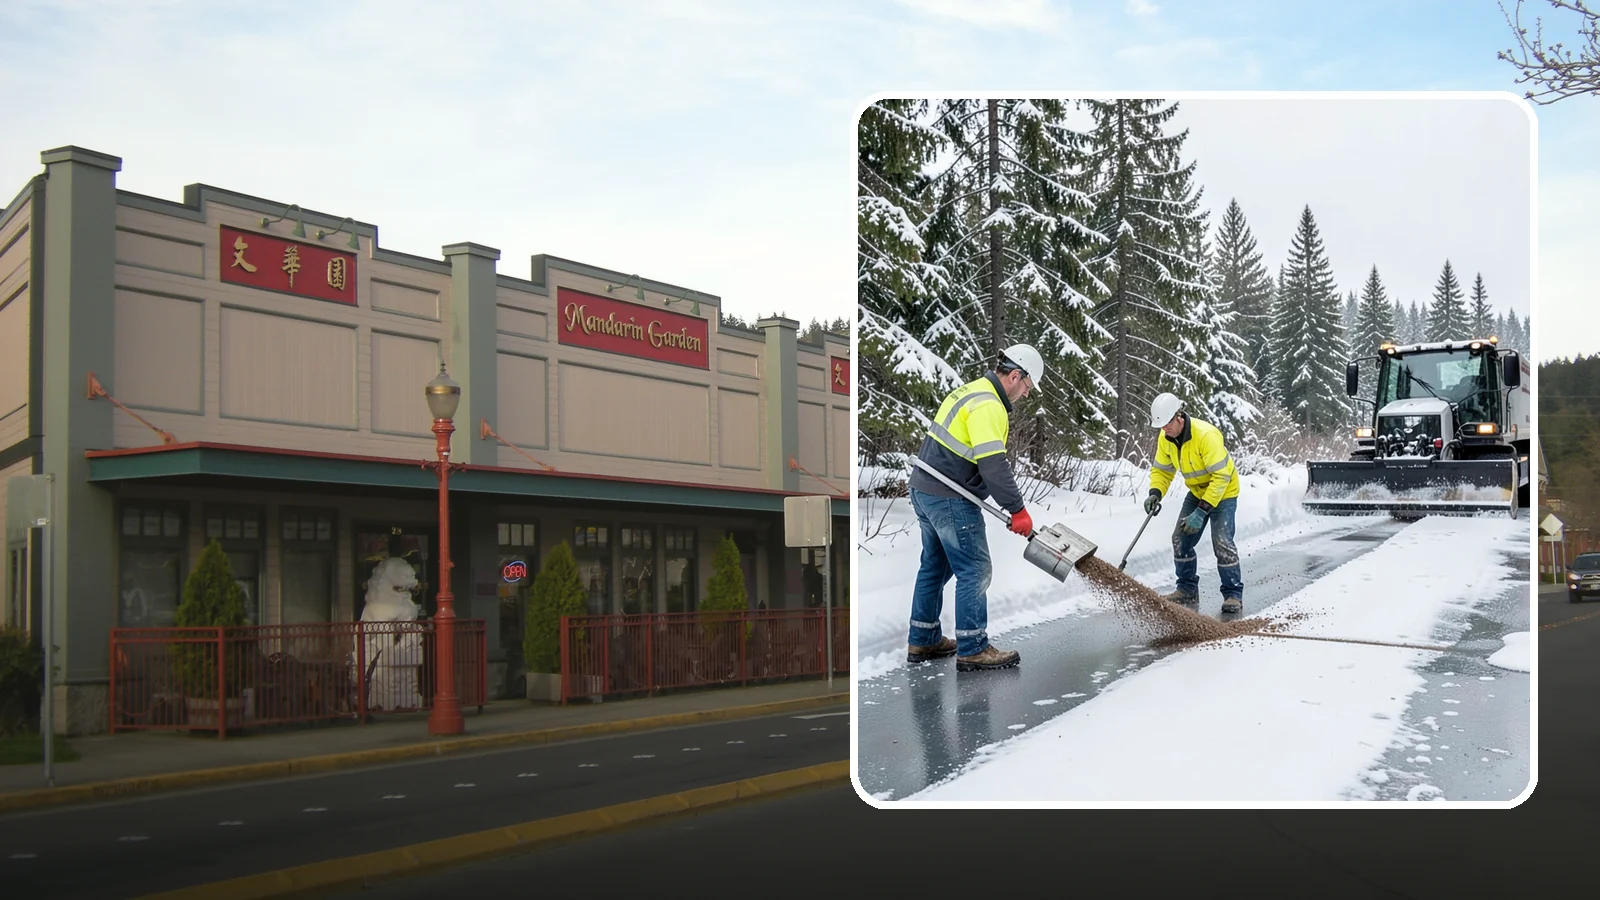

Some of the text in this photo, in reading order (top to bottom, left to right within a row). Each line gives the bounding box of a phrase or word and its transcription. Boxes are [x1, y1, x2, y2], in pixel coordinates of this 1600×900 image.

[231, 235, 346, 290] 文華園
[564, 302, 701, 351] Mandarin Garden
[503, 565, 527, 578] OPEN
